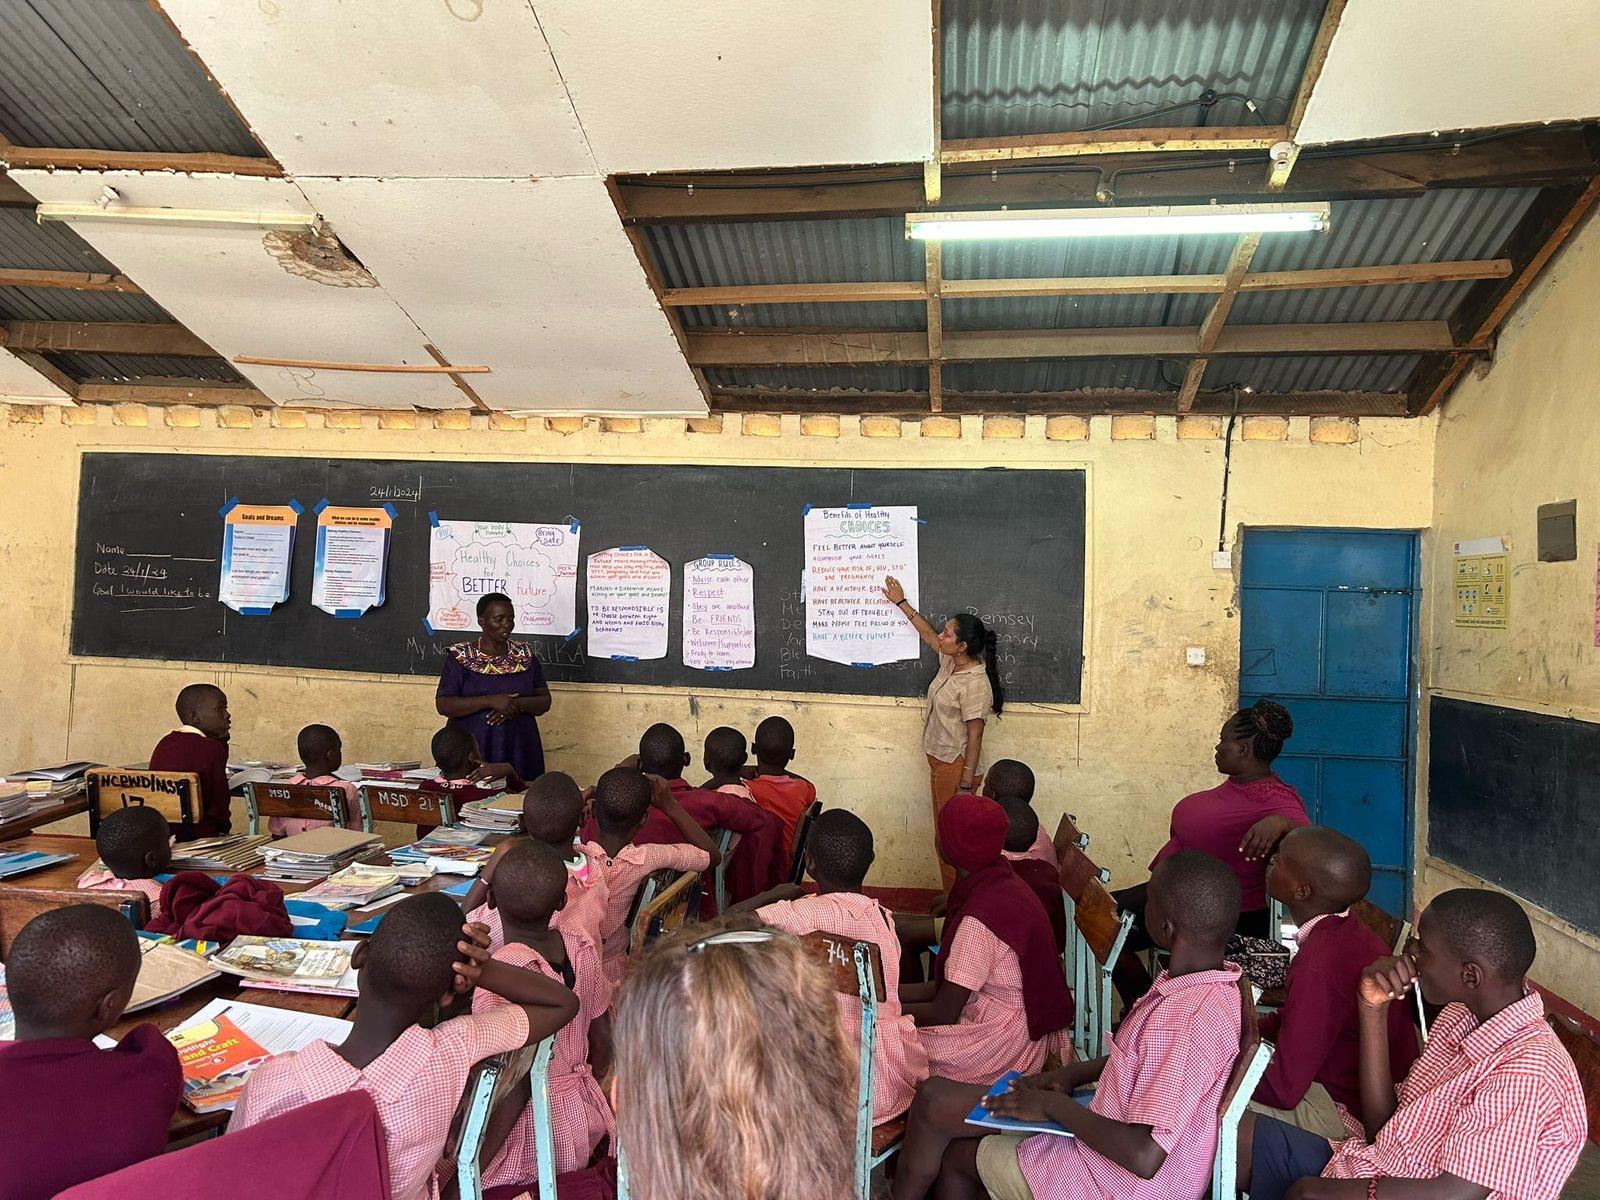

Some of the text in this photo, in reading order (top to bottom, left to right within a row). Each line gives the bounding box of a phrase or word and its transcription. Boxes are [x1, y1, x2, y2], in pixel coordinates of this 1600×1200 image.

[823, 510, 890, 519] Benefits of Healthy
[840, 521, 891, 533] CHOICES
[96, 543, 125, 554] Name
[833, 543, 857, 551] BETTER
[460, 551, 540, 569] Healthy Choices
[718, 559, 741, 568] RULES
[94, 562, 117, 575] Date
[484, 567, 494, 577] for
[93, 583, 114, 597] Goal
[126, 586, 159, 596] would
[164, 586, 181, 597] like
[185, 587, 195, 597] to
[198, 586, 212, 597] be
[462, 577, 508, 594] BETTER
[692, 588, 723, 597] Respect
[692, 614, 742, 624] Be FRIENDS
[812, 620, 828, 628] MAKE
[692, 627, 700, 636] Be
[833, 633, 838, 641] A
[268, 788, 291, 799] MSD
[378, 791, 434, 811] MSD 21
[822, 938, 849, 967] 74
[183, 1048, 207, 1062] and
[207, 1037, 240, 1052] Craft
